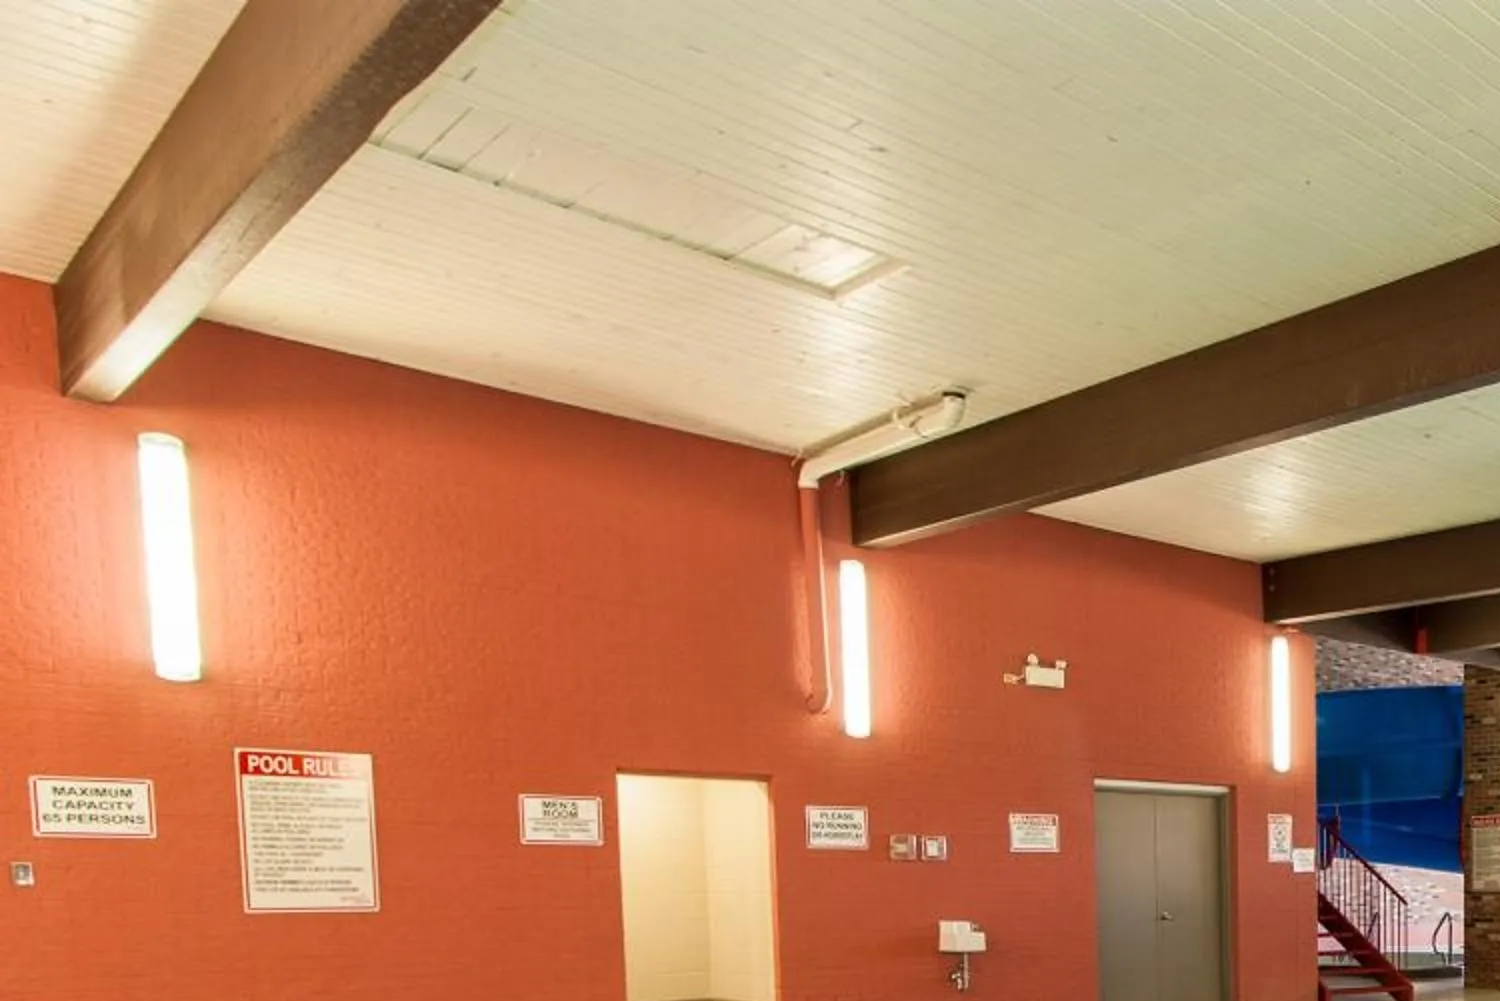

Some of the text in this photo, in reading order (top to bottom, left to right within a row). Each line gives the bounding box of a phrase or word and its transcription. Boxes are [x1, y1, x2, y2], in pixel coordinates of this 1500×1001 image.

[246, 754, 300, 775] POOL
[52, 786, 133, 798] MAXIMUM
[52, 799, 135, 811] CAPACITY
[42, 812, 146, 825] 65 PERSONS
[543, 808, 578, 818] ROOM
[819, 811, 855, 820] PLEASE
